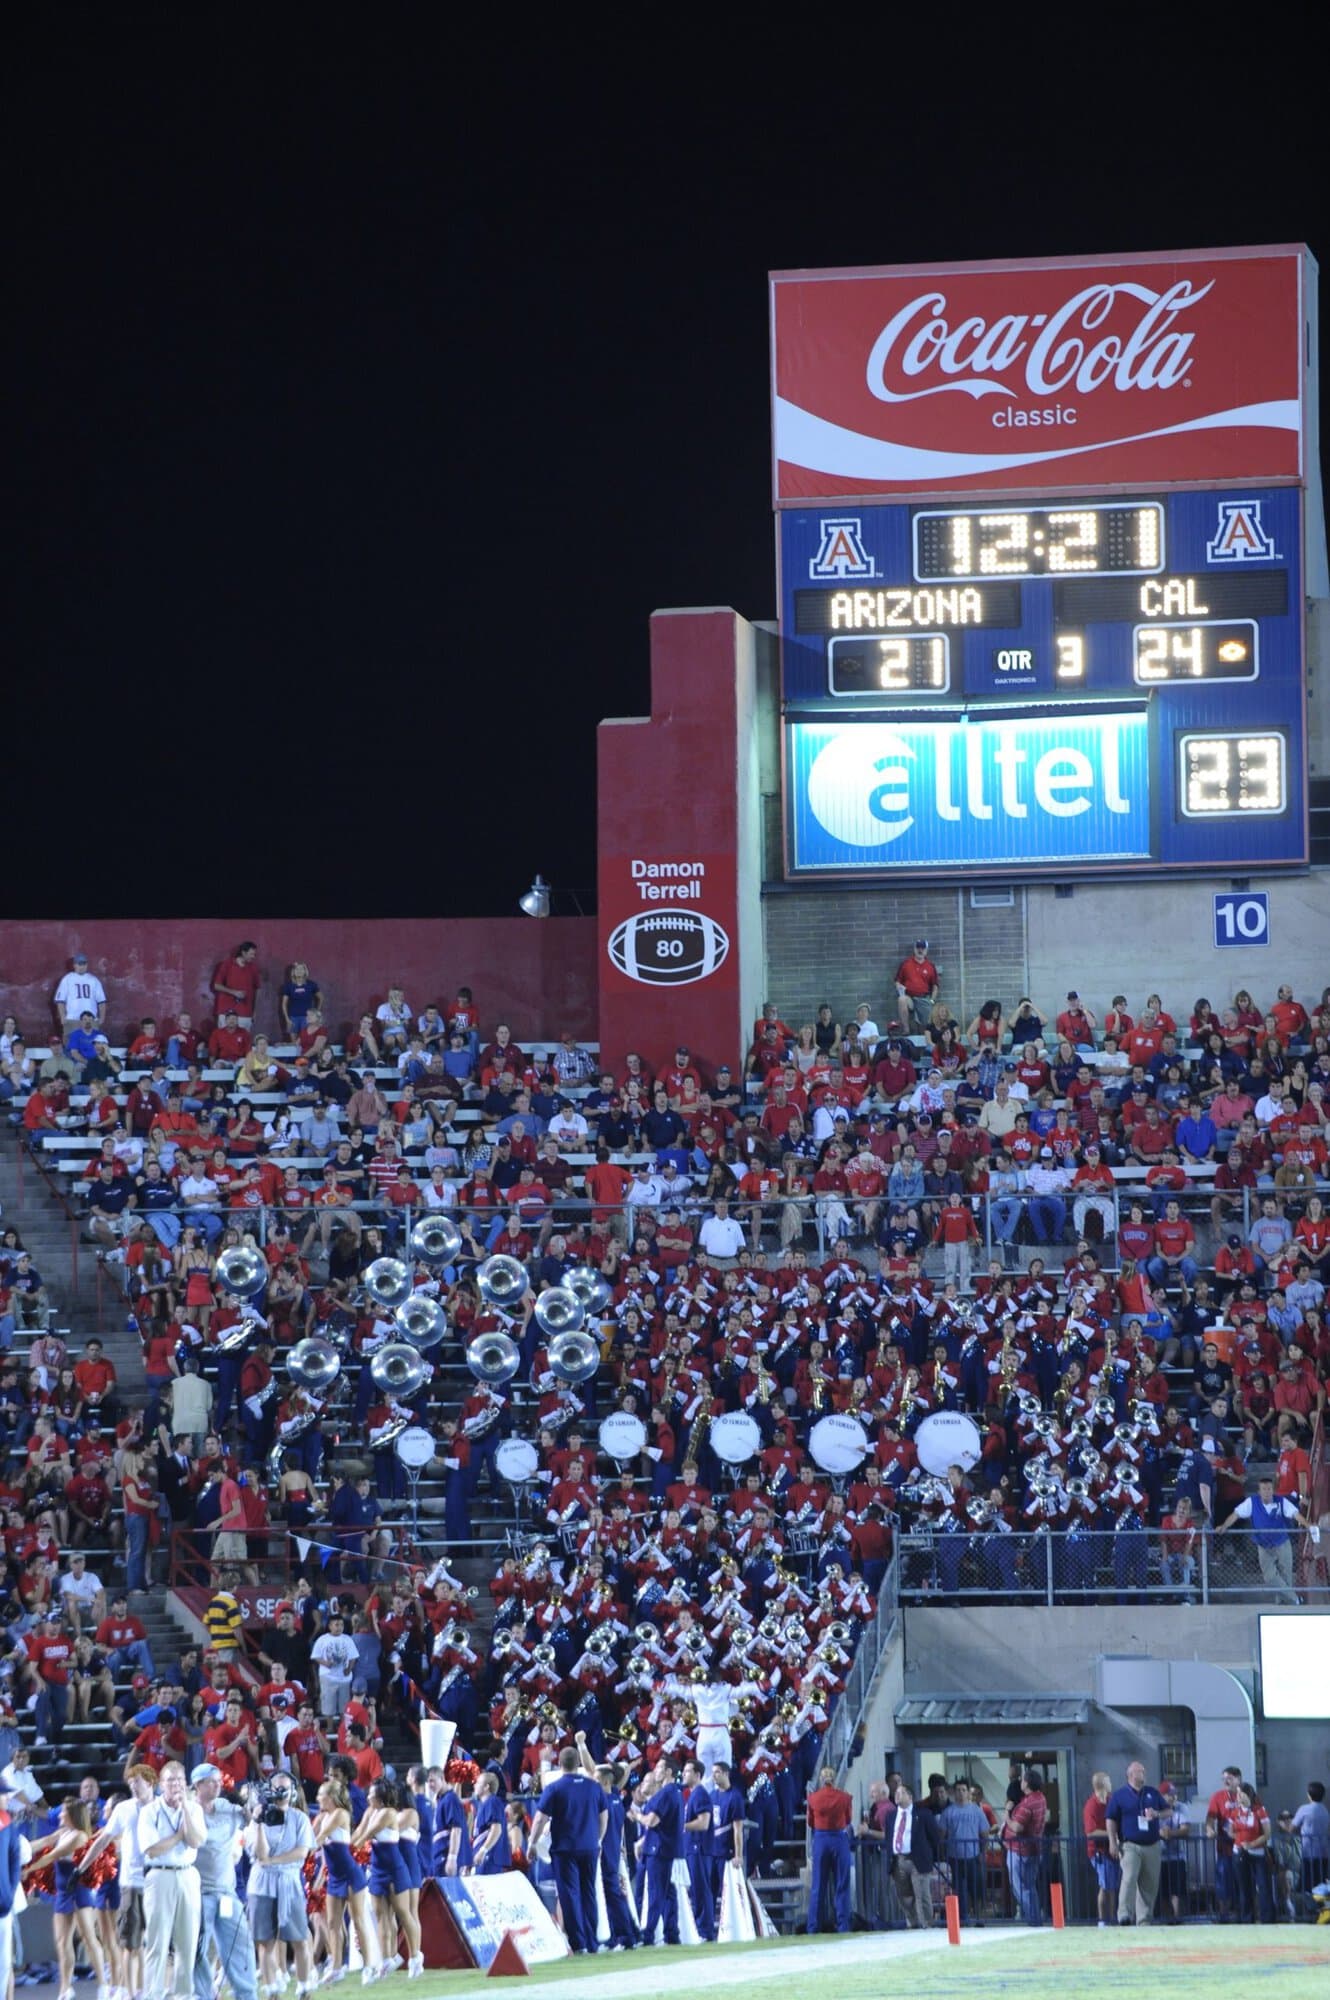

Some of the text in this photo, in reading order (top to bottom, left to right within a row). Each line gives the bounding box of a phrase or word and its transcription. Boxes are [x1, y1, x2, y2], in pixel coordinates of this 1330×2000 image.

[866, 279, 1216, 403] Coca-Cola
[992, 404, 1077, 428] classic
[952, 508, 1156, 574] 12:21
[830, 588, 982, 630] ARIZONA
[1139, 580, 1209, 617] CAL
[879, 637, 944, 689] 21
[1056, 635, 1083, 677] 3
[1138, 628, 1202, 680] 24
[866, 722, 1131, 826] alltel
[1188, 738, 1280, 811] 23
[631, 859, 705, 879] Damon
[636, 880, 701, 900] Terrell
[1216, 900, 1267, 938] 10
[656, 940, 684, 957] 80
[75, 983, 91, 999] 10
[1310, 1231, 1320, 1250] 1
